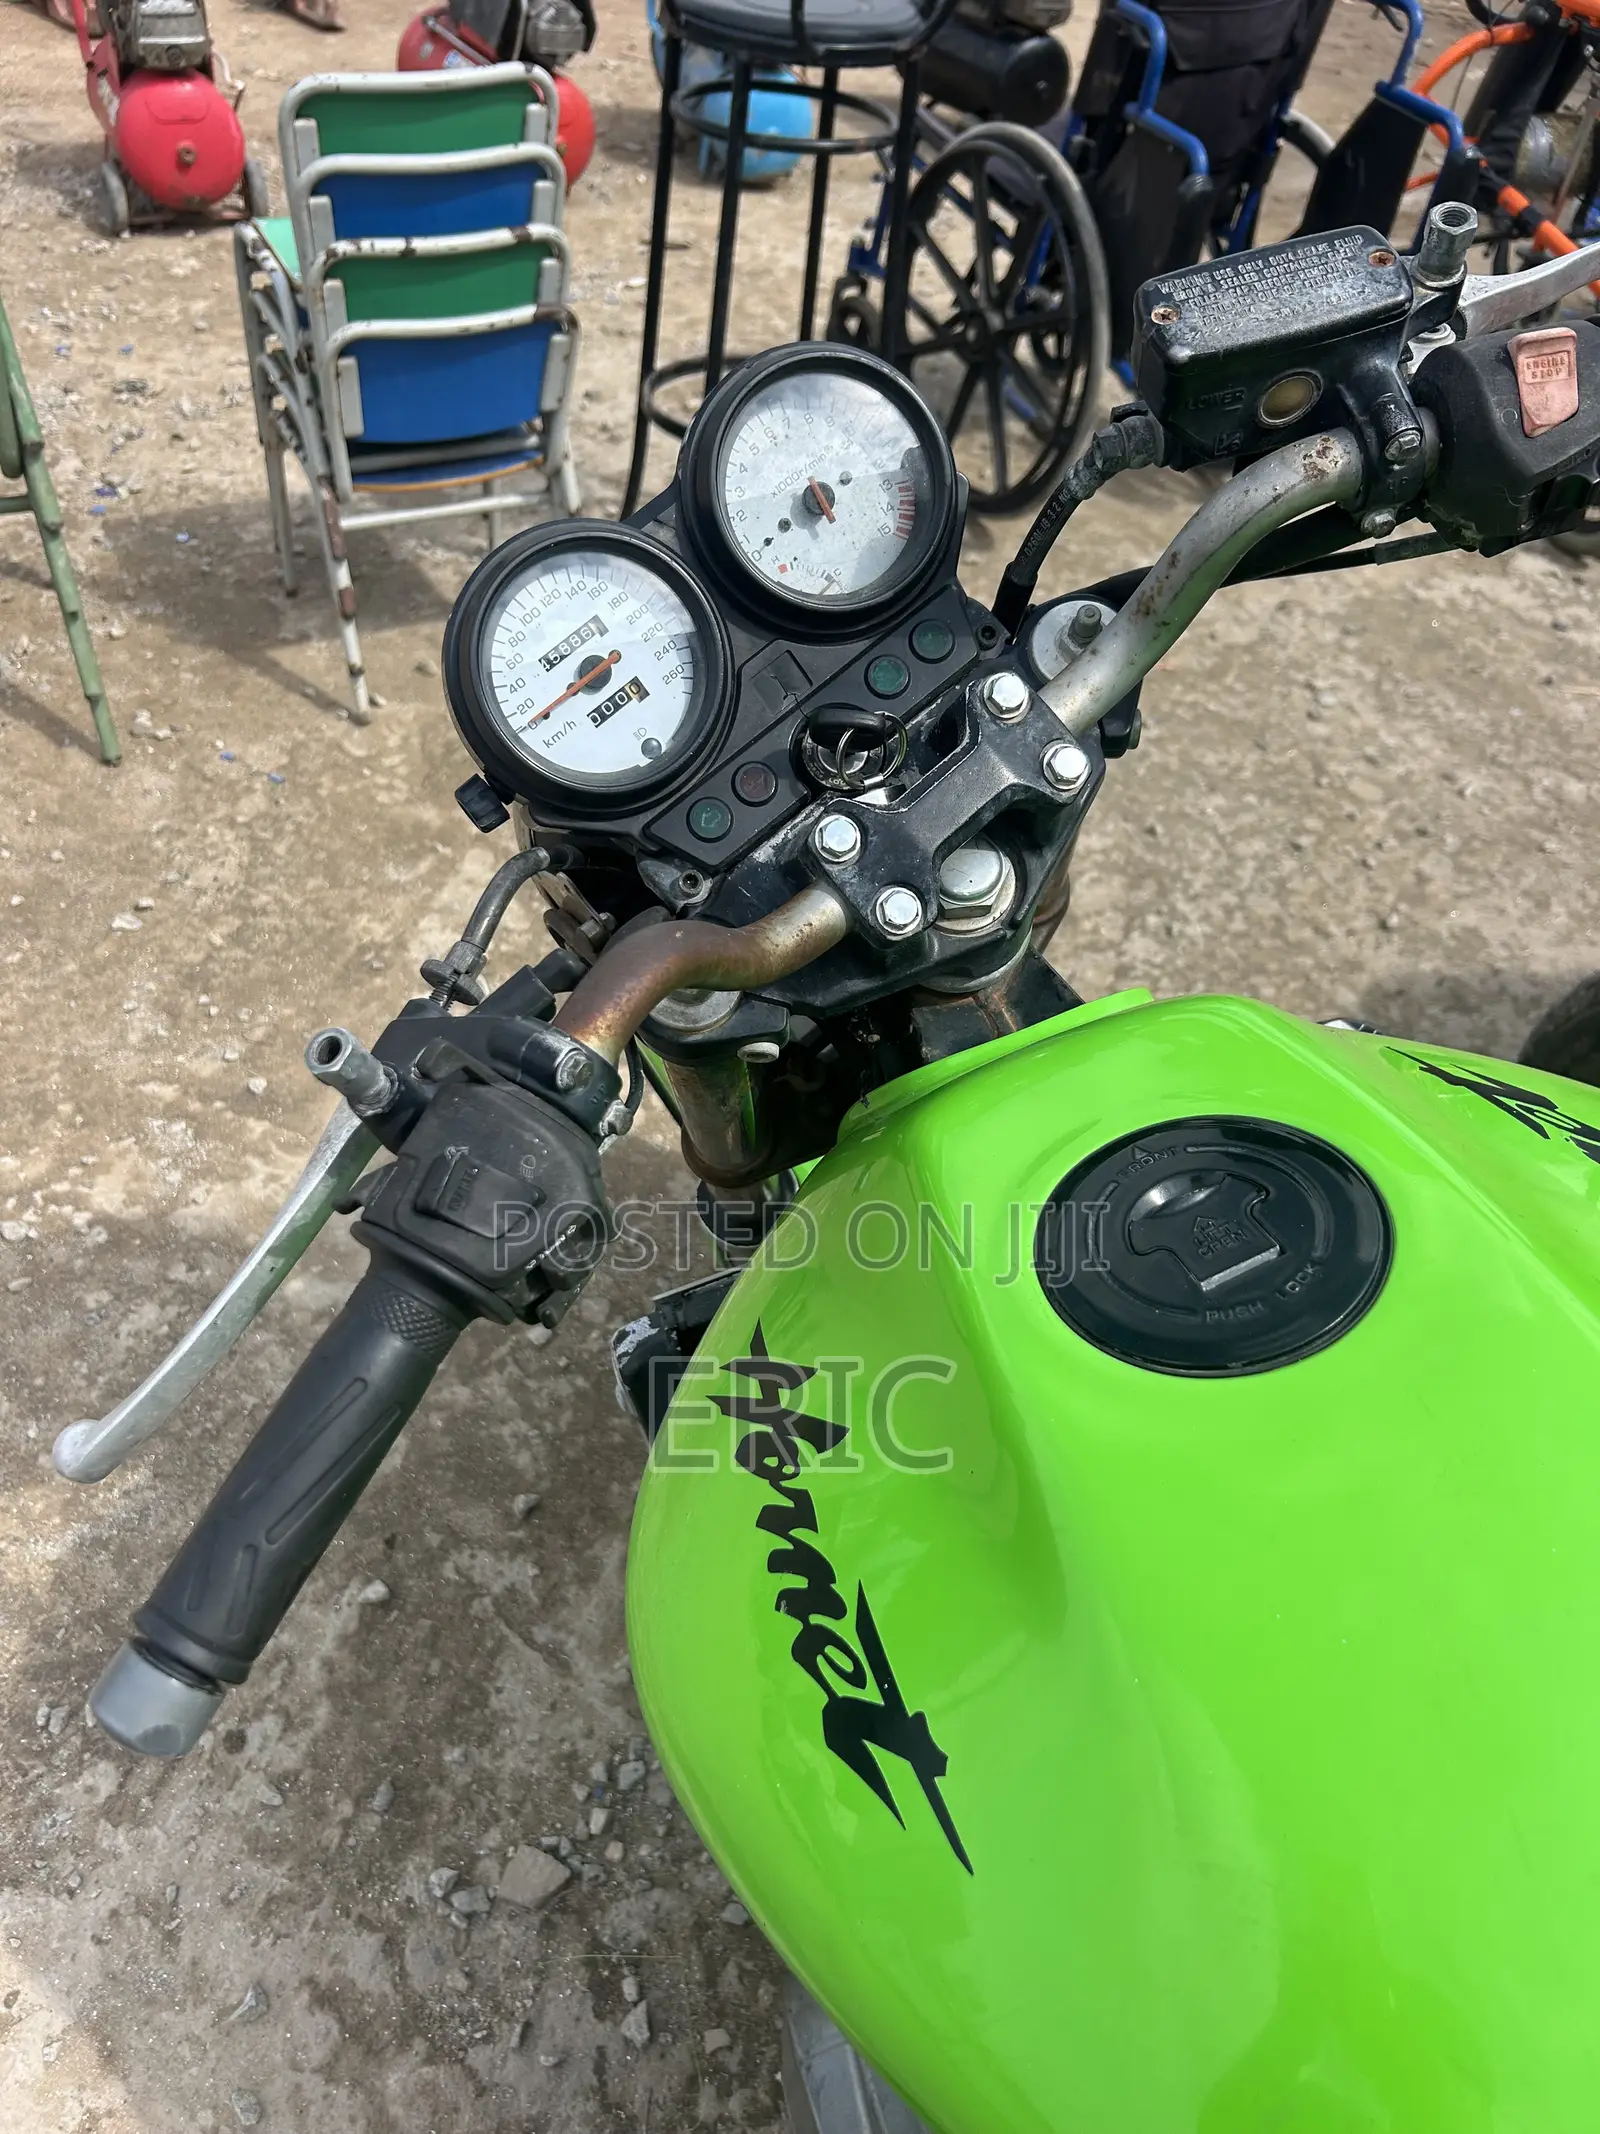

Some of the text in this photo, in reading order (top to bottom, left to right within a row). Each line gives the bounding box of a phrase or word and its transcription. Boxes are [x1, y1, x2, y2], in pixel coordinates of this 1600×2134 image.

[1158, 271, 1212, 294] WARNING
[1213, 267, 1235, 280] USE
[1238, 260, 1264, 274] ONLY
[1269, 252, 1296, 266] DOT4
[1334, 234, 1364, 249] FLUID
[1172, 286, 1204, 301] FROM
[1206, 283, 1216, 293] A
[1220, 272, 1259, 289] SEALED
[1526, 355, 1565, 370] ENGINE
[1531, 367, 1562, 380] STOP
[782, 416, 792, 430] 7
[803, 412, 815, 426] 8
[824, 415, 836, 428] 9
[763, 425, 775, 440] 6
[748, 443, 761, 457] 5
[737, 462, 749, 476] 4
[734, 486, 746, 499] 3
[878, 478, 893, 494] 13
[736, 509, 748, 523] 2
[881, 502, 896, 517] 14
[877, 522, 892, 538] 15
[540, 588, 562, 609] 120
[564, 580, 587, 601] 140
[587, 581, 610, 601] 160
[607, 591, 630, 611] 180
[519, 607, 542, 627] 100
[626, 603, 650, 625] 200
[508, 631, 527, 648] 80
[640, 622, 664, 643] 220
[653, 639, 677, 662] 240
[505, 652, 524, 671] 60
[662, 663, 685, 685] 260
[508, 677, 527, 695] 40
[516, 697, 535, 716] 20
[542, 719, 577, 749] km/h
[1117, 1147, 1177, 1178] FRONT
[1205, 1300, 1265, 1322] PUSH
[705, 1316, 974, 1876] Hornet
